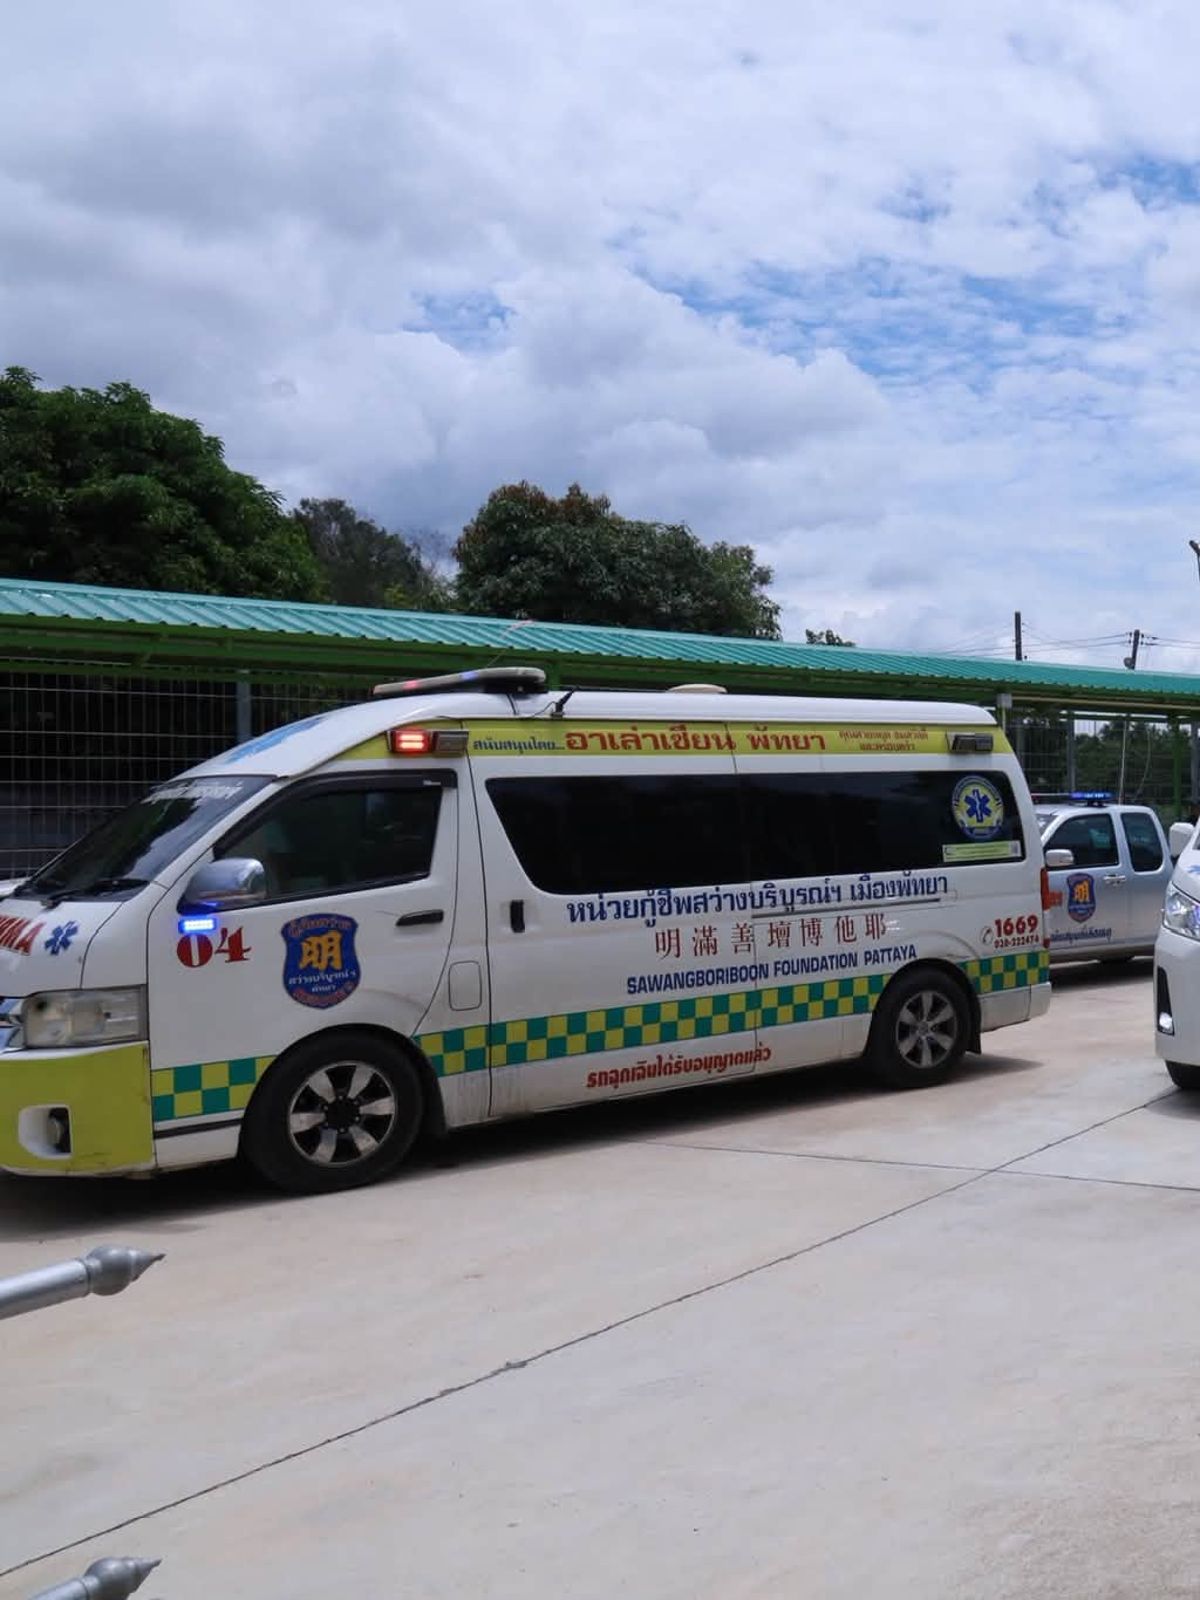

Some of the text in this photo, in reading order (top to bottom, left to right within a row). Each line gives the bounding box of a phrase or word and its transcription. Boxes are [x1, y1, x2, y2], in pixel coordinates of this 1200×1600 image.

[747, 723, 826, 751] พัทยา
[850, 869, 948, 901] เมืองพัทยา
[994, 914, 1039, 938] 1669
[176, 925, 252, 968] 04
[626, 944, 918, 995] SAWANGBORIBOON FOUNDATION PATTAYA
